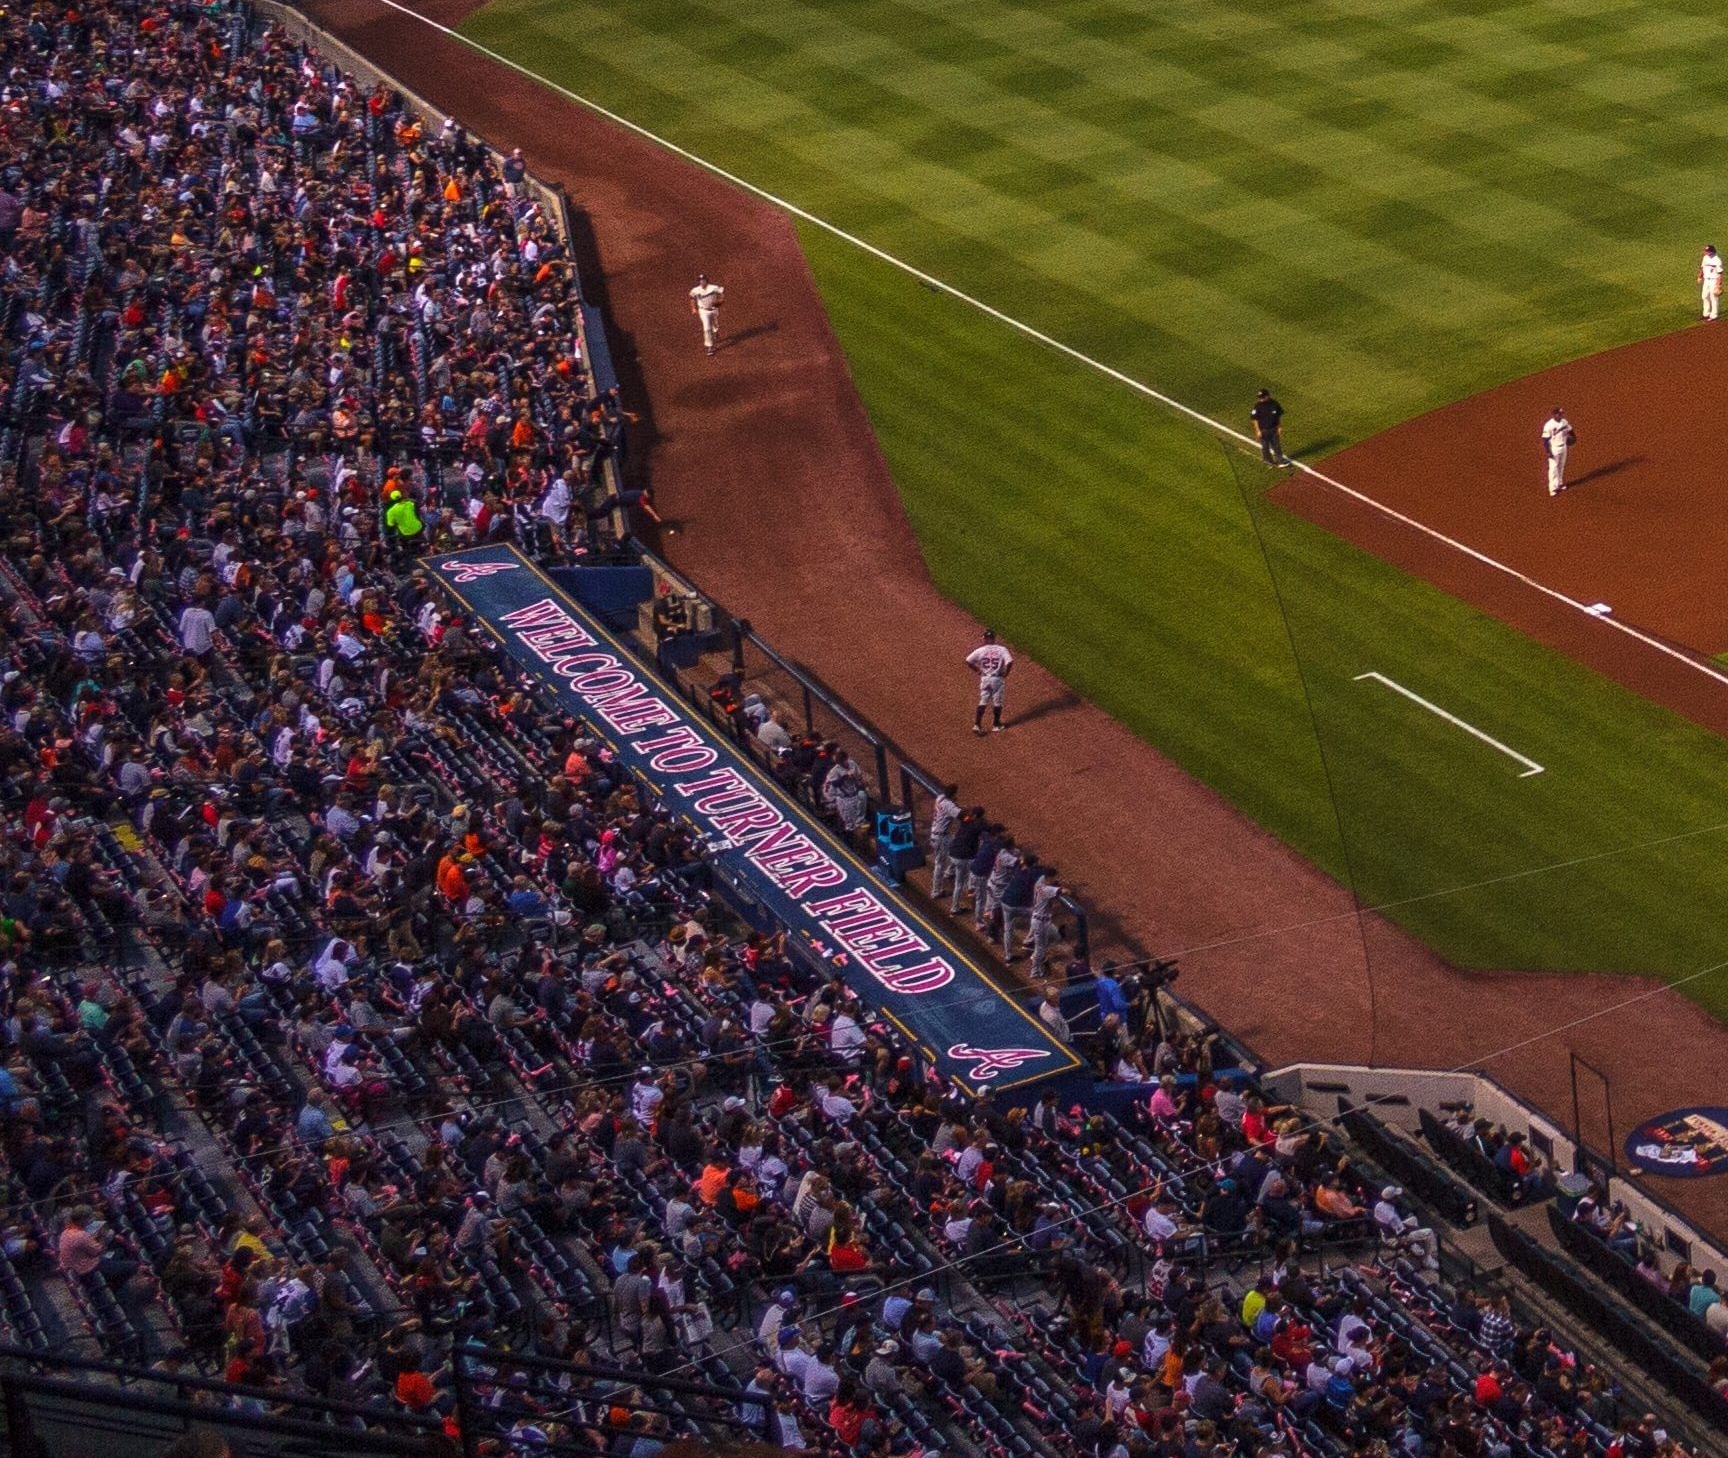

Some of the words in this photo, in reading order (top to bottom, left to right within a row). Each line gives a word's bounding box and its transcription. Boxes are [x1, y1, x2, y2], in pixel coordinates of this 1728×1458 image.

[500, 598, 678, 735] WELCOME
[633, 725, 719, 774] TO
[676, 767, 849, 900] TURNER
[802, 887, 956, 995] FIELD
